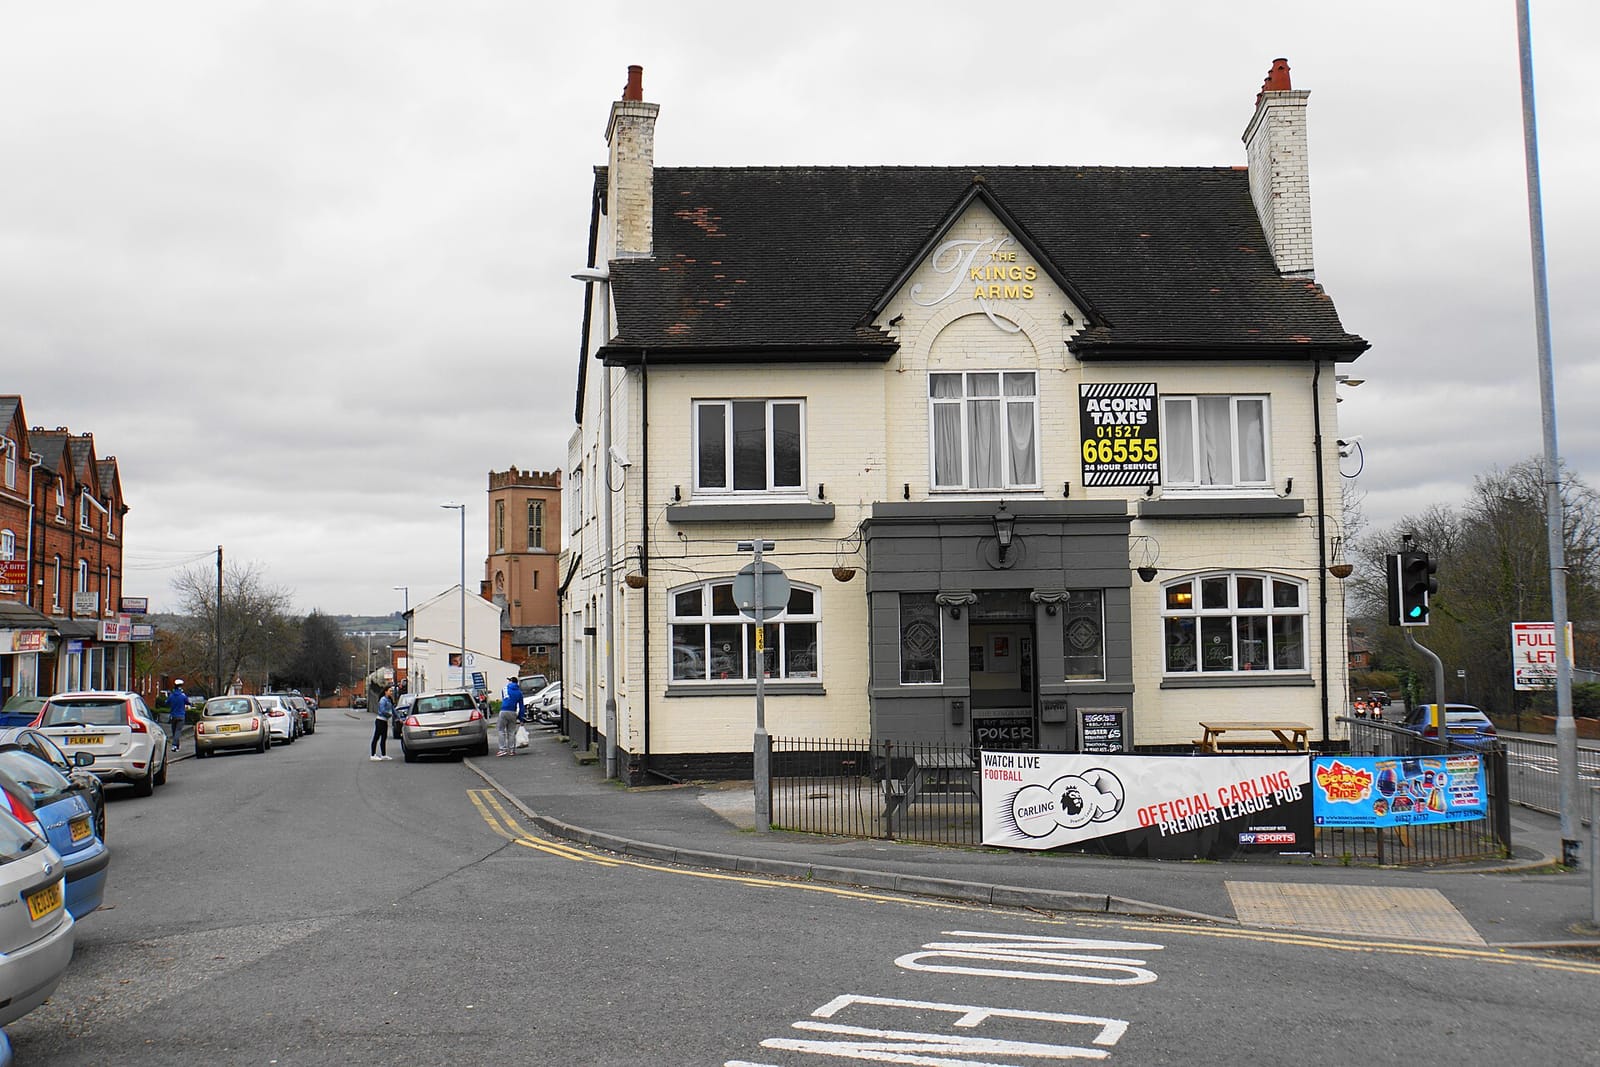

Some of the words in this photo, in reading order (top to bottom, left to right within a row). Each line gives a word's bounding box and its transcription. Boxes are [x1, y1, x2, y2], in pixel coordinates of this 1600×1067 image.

[990, 252, 1016, 263] THE
[970, 266, 1037, 281] KINGS
[974, 284, 1035, 300] ARMS
[1086, 398, 1152, 412] ACORN
[1090, 412, 1148, 425] TAXIS
[1096, 426, 1141, 438] 01527
[1082, 438, 1158, 463] 66555
[1517, 634, 1556, 646] FULL
[1527, 651, 1556, 663] LET
[977, 727, 1032, 741] POKER
[984, 754, 1014, 768] WATCH
[1018, 757, 1040, 768] LIVE
[984, 768, 1022, 781] FOOTBALL
[1318, 773, 1370, 787] BOUNCE
[1136, 794, 1216, 828] OFFICIAL
[1218, 770, 1291, 807] CARLING
[1329, 786, 1357, 798] RIDE
[1017, 800, 1054, 818] CARLING
[1158, 810, 1221, 837] PREMIER
[1222, 791, 1273, 822] LEAGUE
[1274, 784, 1303, 808] PUB
[1241, 834, 1255, 843] sky
